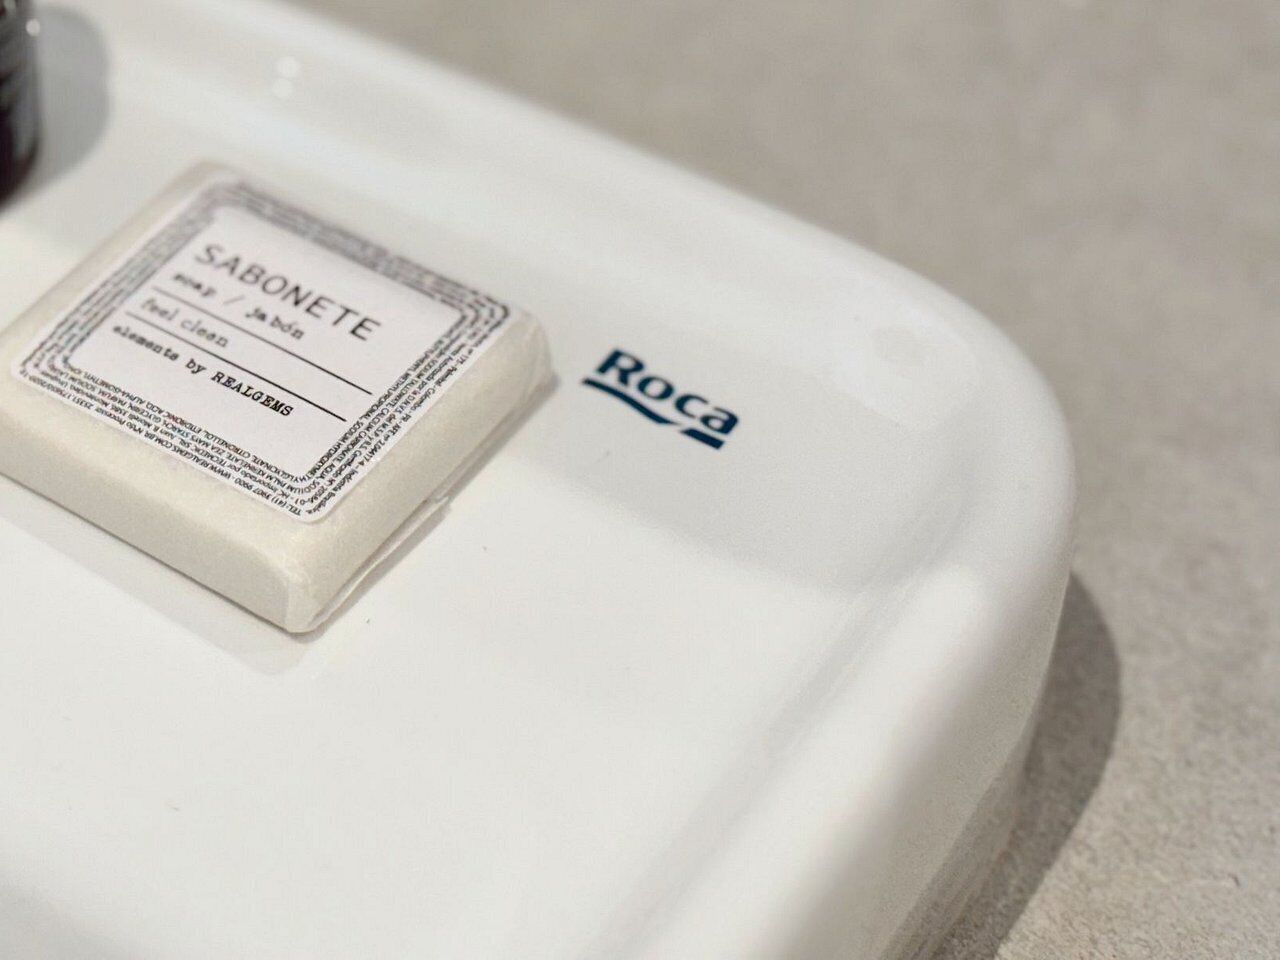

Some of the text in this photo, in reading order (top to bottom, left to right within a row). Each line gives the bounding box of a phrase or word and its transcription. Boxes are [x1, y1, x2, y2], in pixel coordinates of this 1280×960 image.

[140, 297, 229, 348] feel clean
[172, 271, 217, 301] soap
[244, 304, 306, 340] jabón
[196, 243, 381, 342] SABONETE
[113, 324, 295, 417] elements by REALGEMS
[596, 348, 739, 435] Roca
